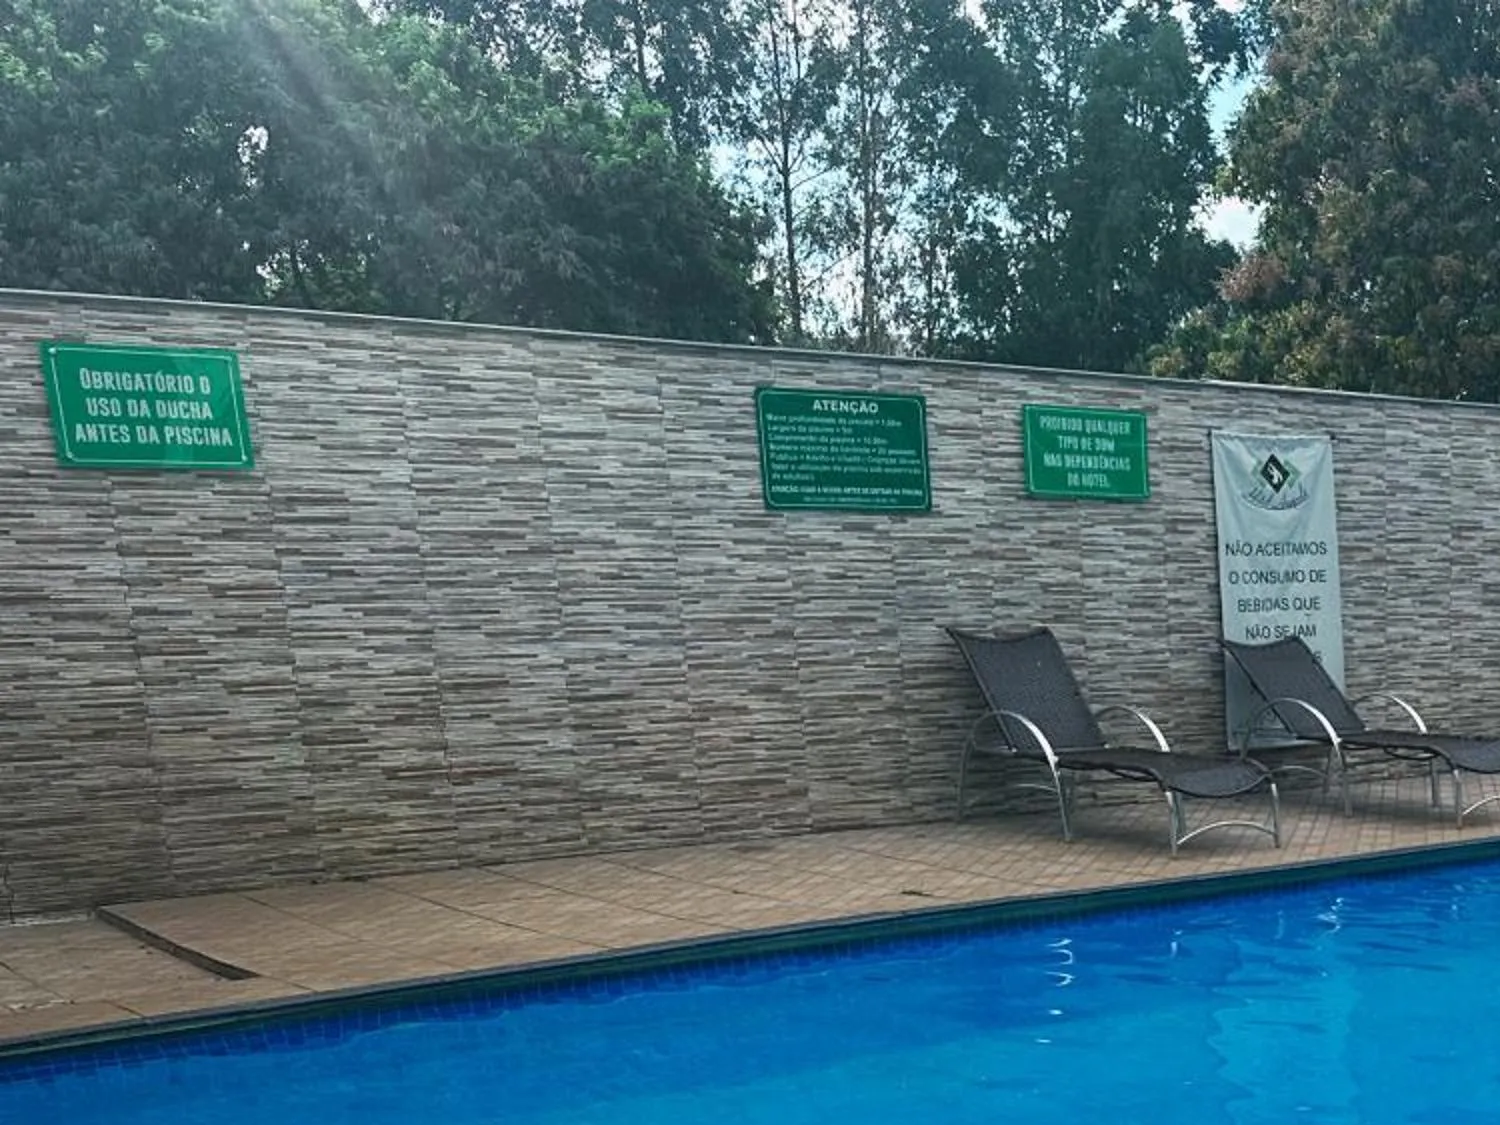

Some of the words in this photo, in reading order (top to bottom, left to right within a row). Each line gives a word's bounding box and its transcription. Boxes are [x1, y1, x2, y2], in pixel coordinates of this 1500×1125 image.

[79, 367, 195, 393] OBRIGATÓRIO
[199, 375, 211, 394] O
[86, 397, 122, 417] USO
[127, 398, 150, 418] DA
[156, 399, 213, 420] DUCHA
[813, 398, 879, 414] ATENÇÃO
[75, 424, 130, 443] ANTES
[136, 425, 160, 444] DA
[164, 427, 233, 446] PISCINA
[1057, 435, 1078, 449] TIPO
[1081, 437, 1093, 451] DE
[1225, 540, 1253, 557] NÃO
[1255, 541, 1328, 556] ACEITAMOS
[1228, 571, 1239, 585] O
[1241, 569, 1305, 584] CONSUMO
[1308, 569, 1327, 583] DE
[1237, 597, 1289, 613] BEBIDAS
[1292, 597, 1322, 612] QUE
[1245, 624, 1271, 640] NÃO
[1273, 624, 1317, 639] SEJAM
